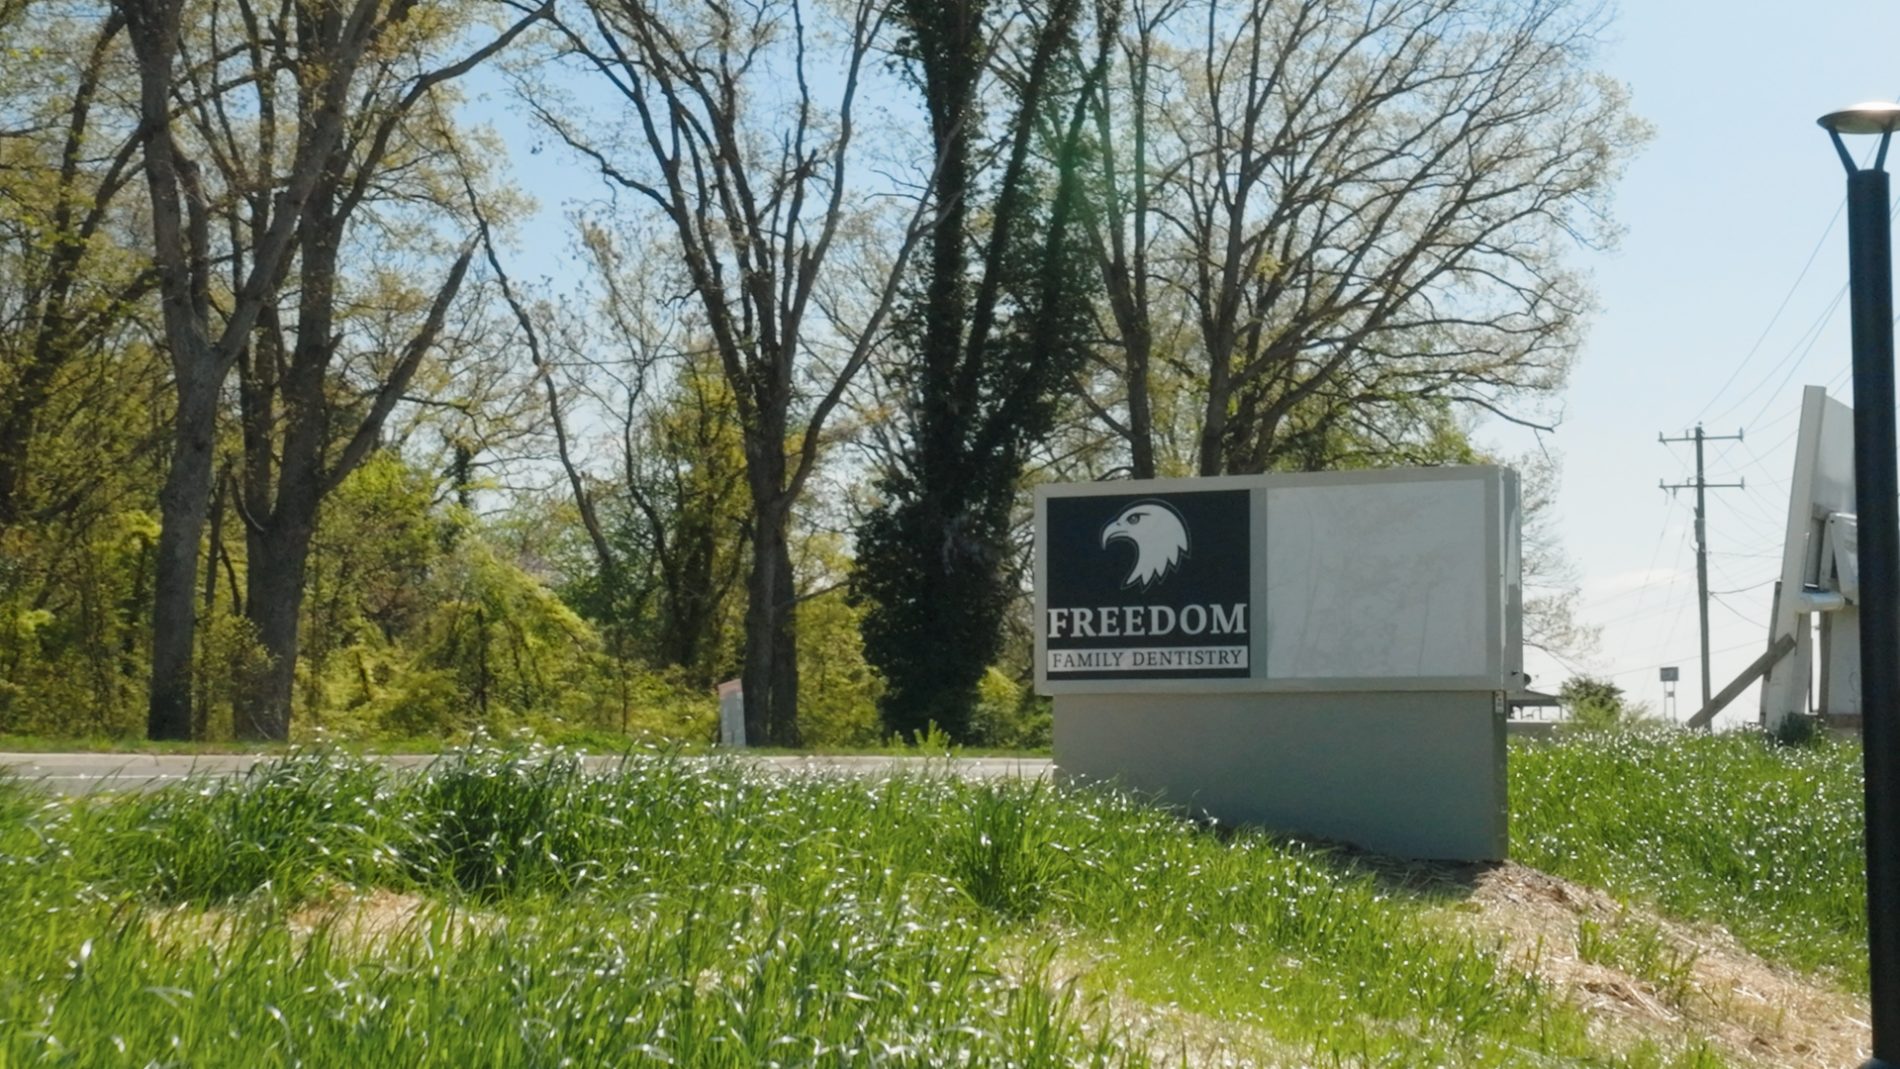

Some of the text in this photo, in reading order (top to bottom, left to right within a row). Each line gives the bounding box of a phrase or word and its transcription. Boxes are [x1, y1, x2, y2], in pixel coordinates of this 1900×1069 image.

[1048, 603, 1247, 638] FREEDOM
[1053, 649, 1242, 668] FAMILY DENTISTRY
